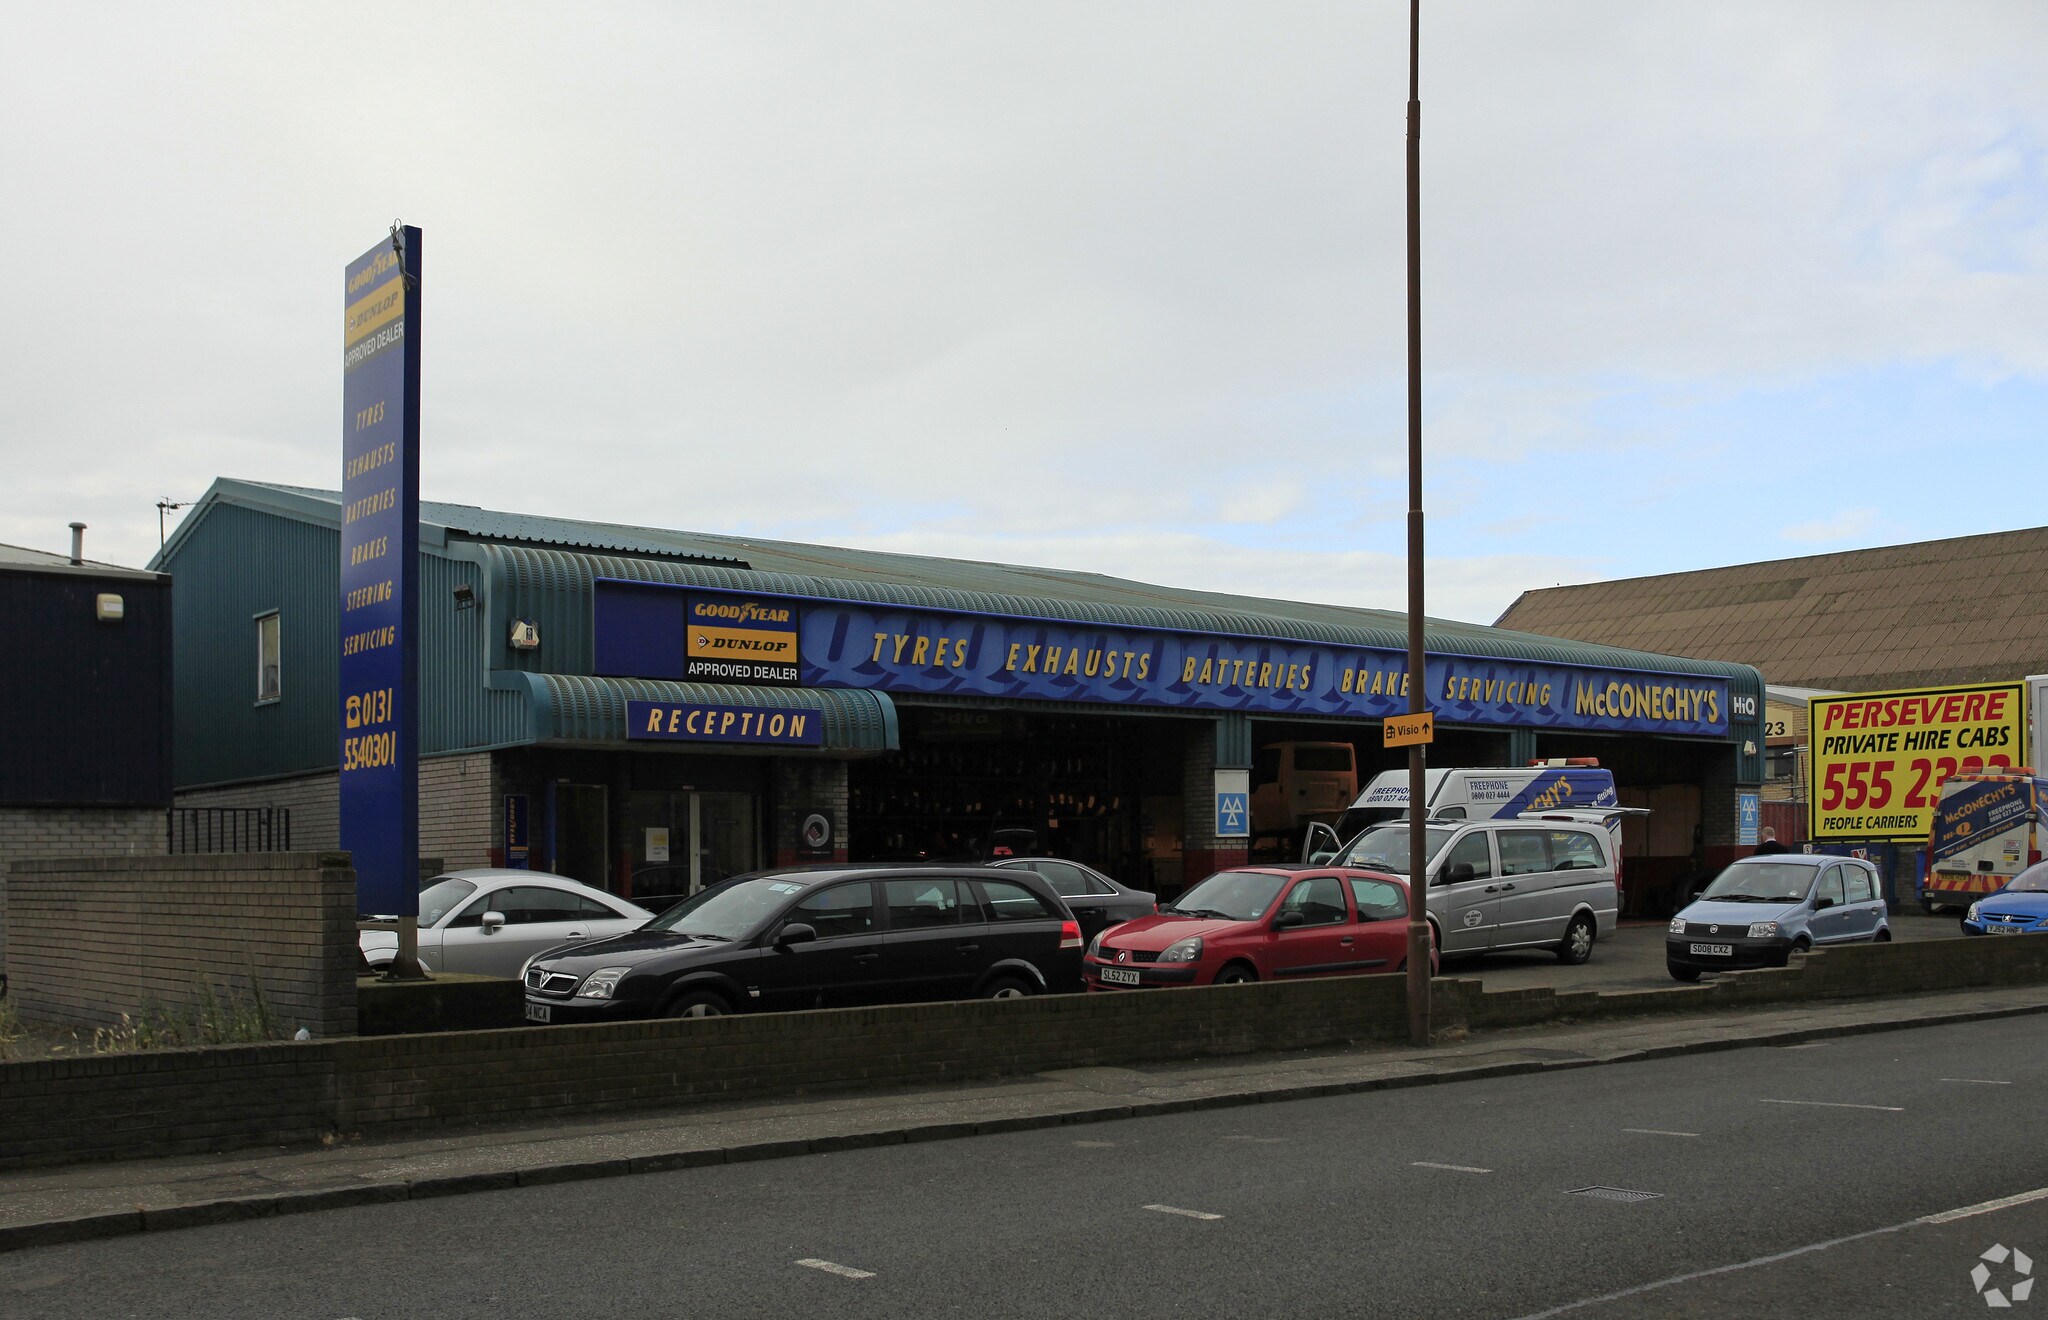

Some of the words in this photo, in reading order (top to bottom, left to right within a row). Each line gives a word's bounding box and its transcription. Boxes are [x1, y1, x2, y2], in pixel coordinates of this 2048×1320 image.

[356, 291, 398, 328] DUNLOP
[344, 337, 375, 369] APPROVED
[377, 321, 404, 349] DEALER
[356, 400, 385, 432] TYRES
[347, 442, 395, 481] EXHAUSTS
[346, 487, 396, 525] BATTERIES
[351, 536, 388, 566] BRAKES
[346, 580, 392, 612] STEERING
[343, 626, 395, 656] SERVICING
[712, 637, 788, 652] DUNLOP
[872, 632, 968, 668] TYRES
[688, 662, 751, 678] APPROVED
[754, 666, 798, 681] DEALER
[1005, 643, 1150, 680] EXHAUSTS
[1182, 656, 1311, 690] BATTERIES
[1446, 676, 1551, 706] SERVICING
[1575, 679, 1718, 724] McCONECHY'S
[1733, 696, 1755, 716] HiQ
[363, 687, 393, 726] 0131
[1823, 691, 2009, 731] PERSEVERE
[647, 708, 806, 738] RECEPTION
[1397, 725, 1419, 736] Visio
[1765, 721, 1786, 736] 23
[343, 731, 397, 771] 5540301
[1822, 732, 1900, 755] PRIVATE
[1903, 729, 1952, 751] HIRE
[1956, 725, 2010, 748] CABS
[1469, 781, 1508, 790] FREEPHONE
[1471, 791, 1484, 800] 0800
[1485, 791, 1496, 800] 027
[1497, 791, 1510, 799] 4444
[1821, 760, 1895, 811] 555
[1903, 753, 2012, 809] 23
[1823, 815, 1863, 830] PEOPLE
[1865, 814, 1918, 829] CARRIERS
[1988, 798, 2023, 817] FREEPHONE
[1713, 945, 1729, 954] CXZ
[1103, 969, 1121, 982] SL52
[1122, 970, 1137, 983] ZYX
[533, 1005, 547, 1021] NCA
